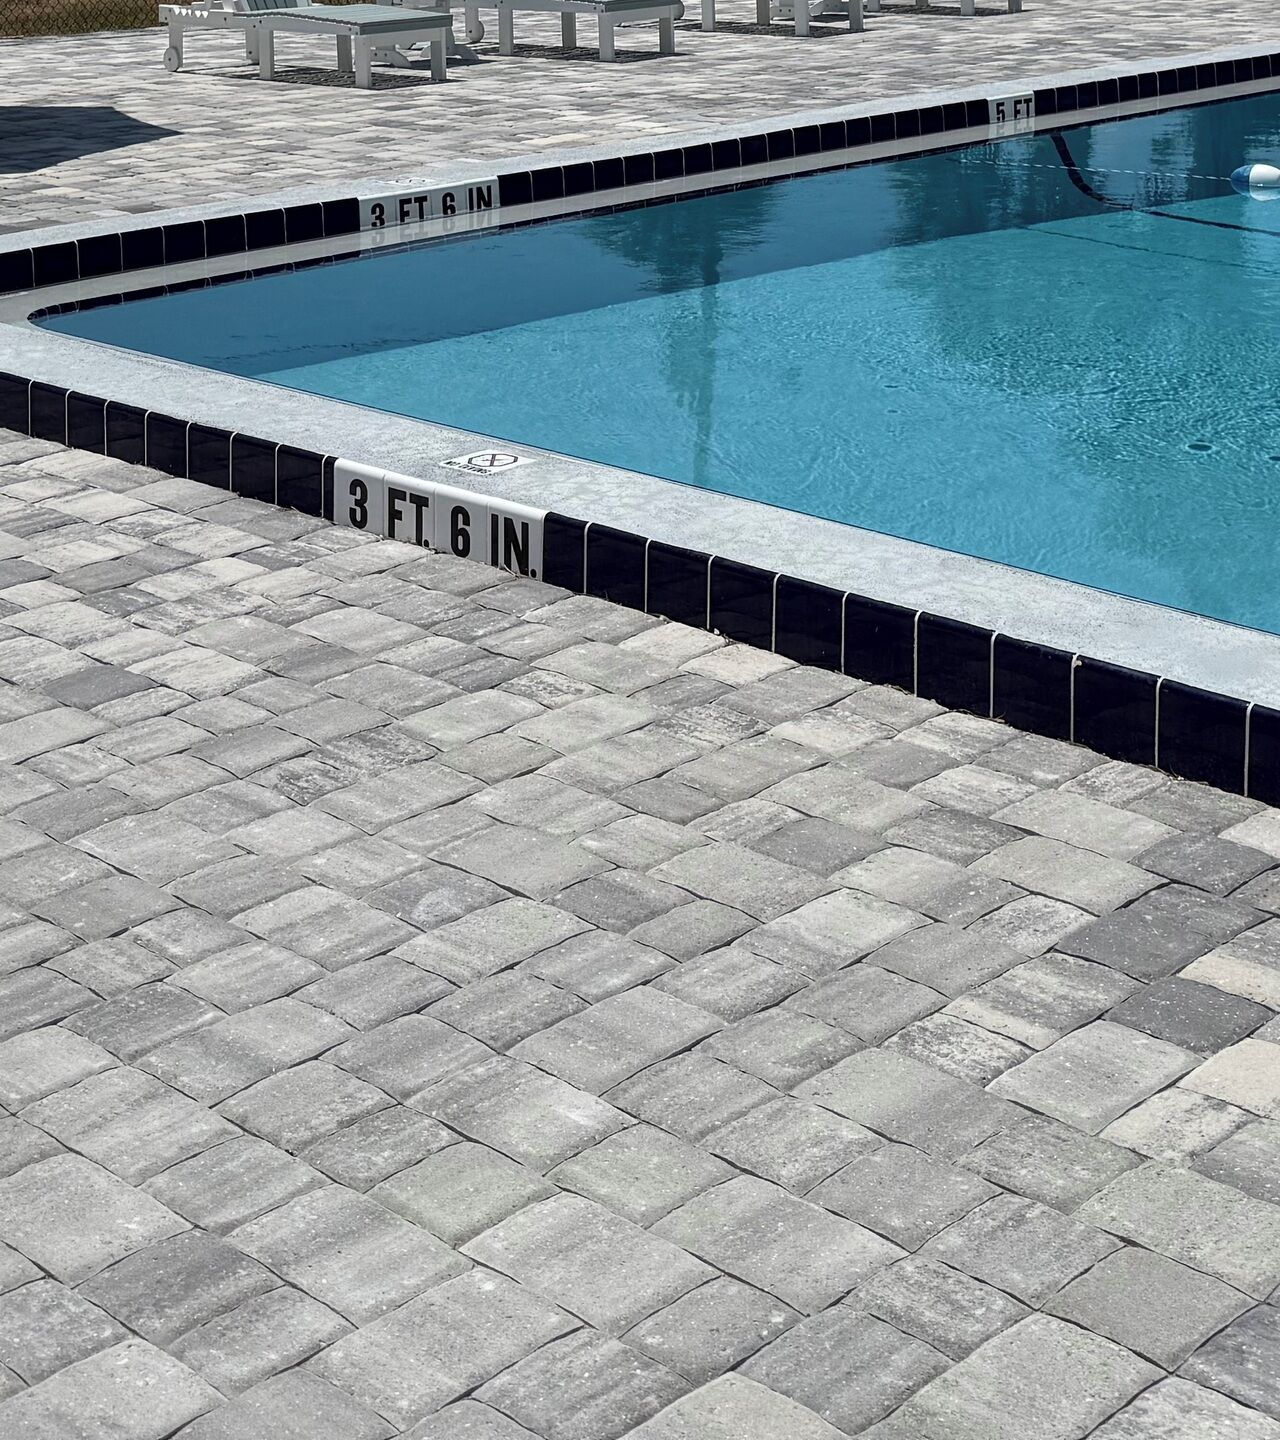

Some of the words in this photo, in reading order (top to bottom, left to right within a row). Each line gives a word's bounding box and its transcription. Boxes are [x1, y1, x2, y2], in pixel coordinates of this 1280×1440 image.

[996, 102, 1006, 122] 5
[1014, 98, 1032, 120] FT
[371, 203, 385, 227] 3
[399, 195, 427, 222] FT
[442, 192, 456, 215] 6
[468, 185, 492, 210] IN
[349, 479, 368, 529] 3
[388, 487, 430, 548] FT.
[450, 505, 470, 558] 6
[491, 513, 537, 578] IN.
